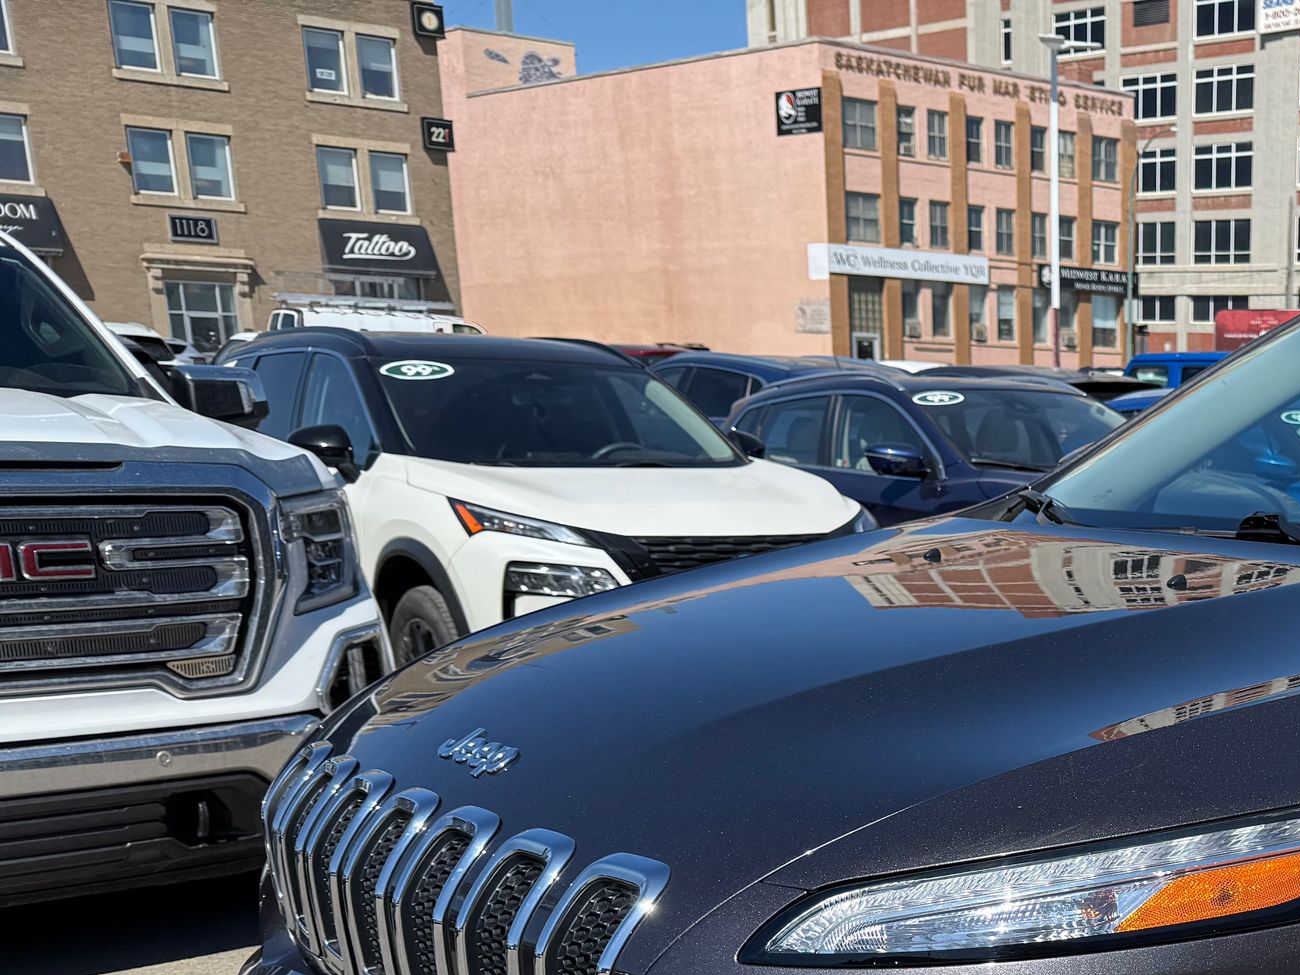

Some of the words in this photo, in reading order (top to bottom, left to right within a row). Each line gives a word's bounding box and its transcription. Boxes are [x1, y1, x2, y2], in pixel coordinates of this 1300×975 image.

[834, 51, 952, 88] SASKATCHEWAN
[175, 218, 209, 237] 1118
[342, 232, 417, 261] Tattoo
[860, 253, 909, 272] Wellness
[910, 258, 961, 276] Collective
[437, 727, 519, 778] Jeep
